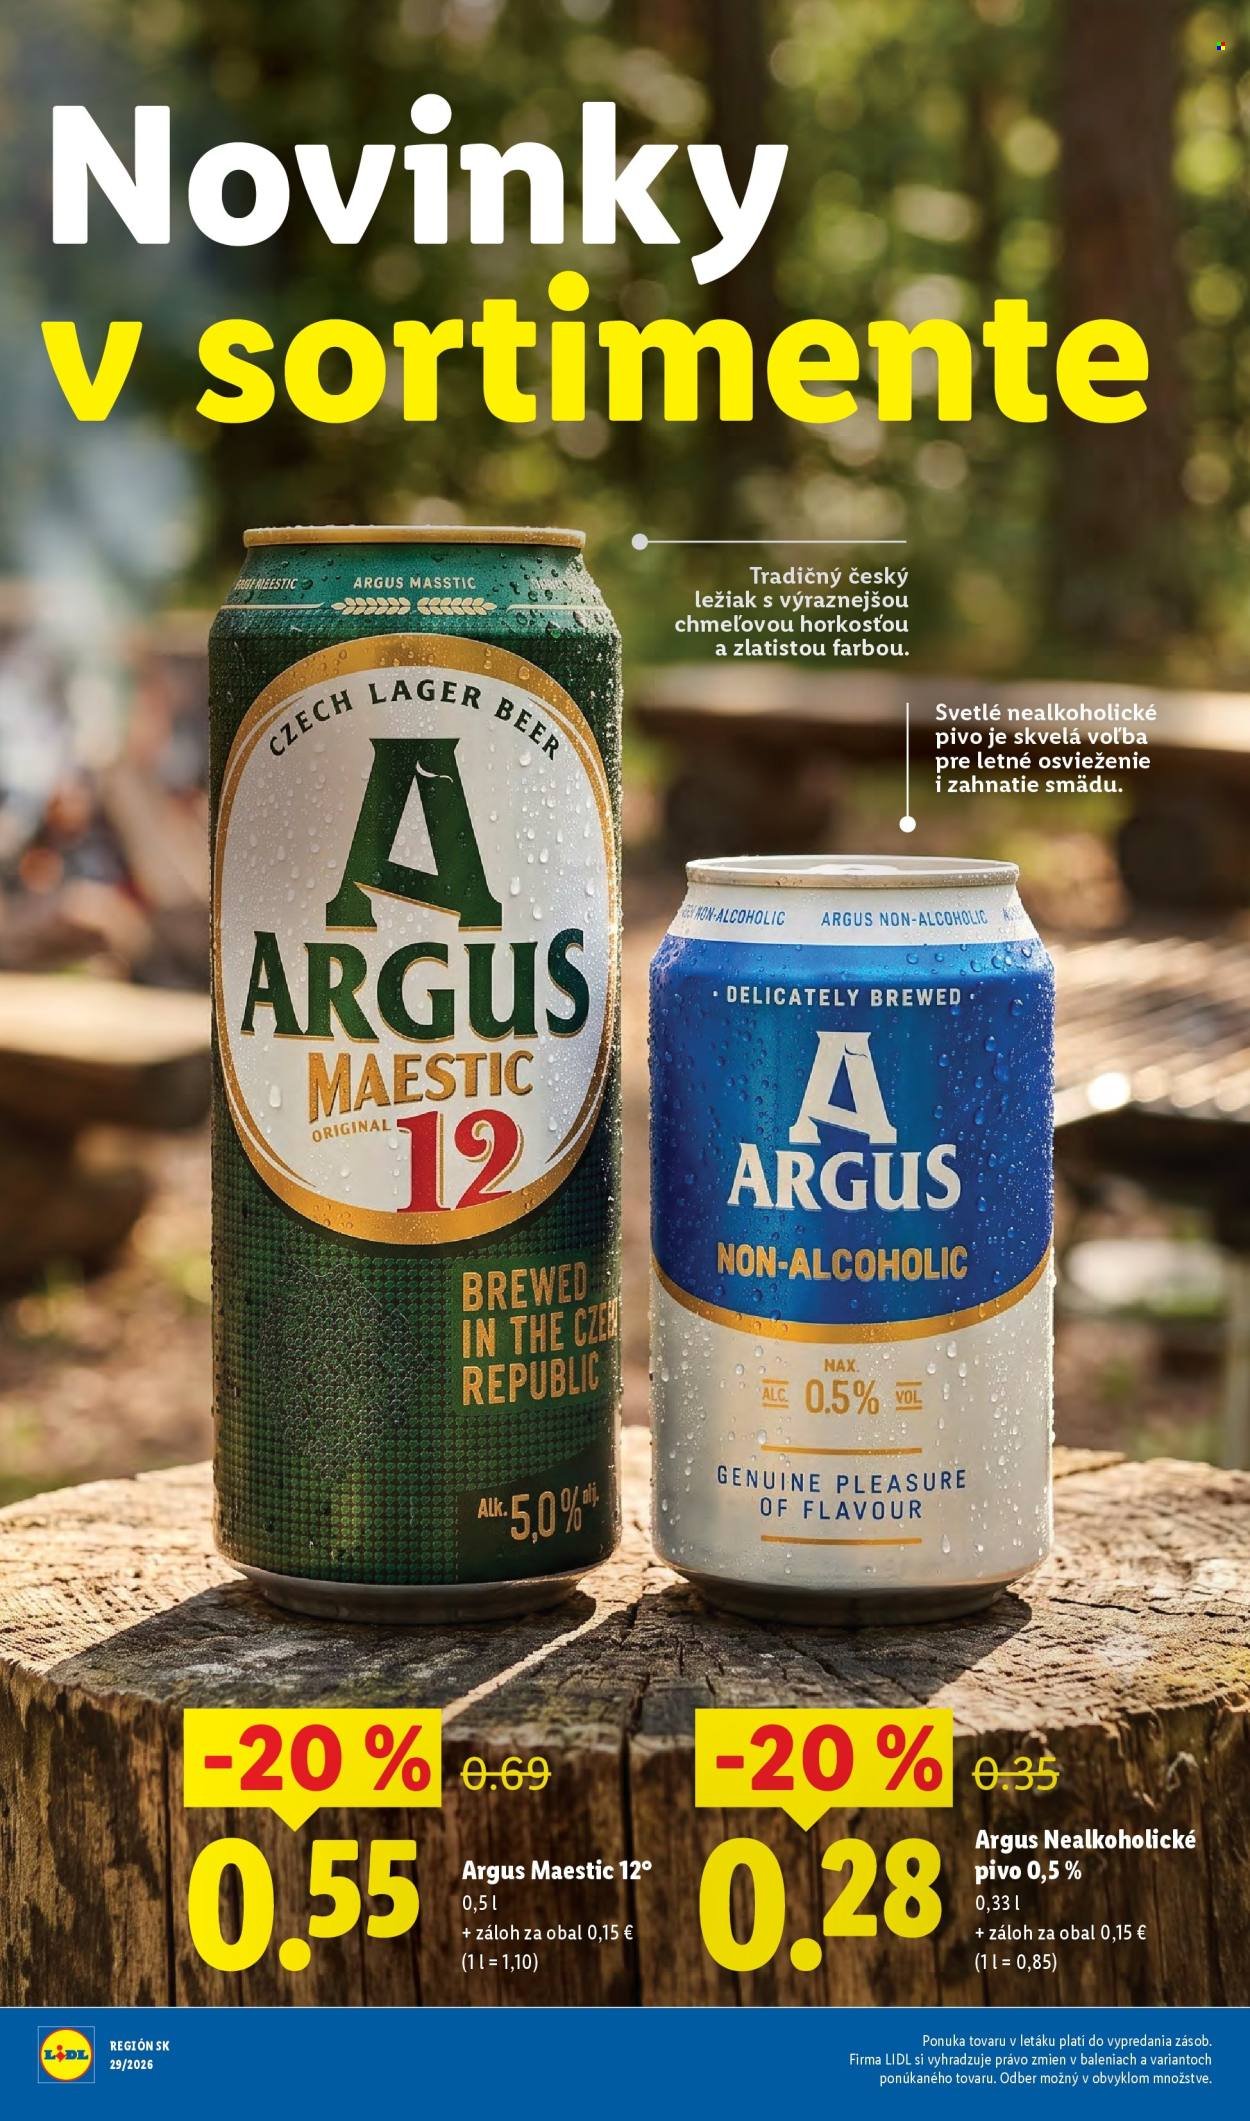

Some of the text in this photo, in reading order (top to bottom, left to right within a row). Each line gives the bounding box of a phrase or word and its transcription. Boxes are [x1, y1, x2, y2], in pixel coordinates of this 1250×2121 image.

[52, 94, 788, 285] Novinky
[41, 270, 1149, 424] v sortimente
[353, 576, 404, 589] ARGUS
[749, 566, 909, 589] Tradičný český
[695, 590, 909, 612] ležiak s výraznejšou
[674, 614, 909, 633] chmeľovou horkosťou
[715, 638, 910, 656] a zlatistou farbou.
[269, 679, 560, 760] CZECH LAGER BEER
[936, 703, 1157, 721] Svetlé nealkoholické
[935, 726, 1148, 749] pivo je skvelá voľba
[935, 751, 1151, 773] pre letné osvieženie
[935, 774, 1123, 793] i zahnatie smädu.
[325, 738, 503, 931] A
[695, 906, 785, 926] NON-ALCOHOLIC
[821, 911, 873, 927] ARGUS
[879, 909, 988, 927] NON-ALCOHOLIC
[240, 928, 590, 1042] ARGUS
[726, 985, 962, 1007] DELICATELY BREWED
[308, 1050, 534, 1124] MAESTIC
[788, 1031, 897, 1145] A
[311, 1109, 524, 1214] ORIGINAL 12
[727, 1142, 962, 1212] ARGUS
[717, 1242, 968, 1282] NON-ALCOHOLIC
[462, 1261, 588, 1312] BREWED
[462, 1317, 495, 1359] IN
[510, 1311, 564, 1354] THE
[462, 1351, 599, 1406] REPUBLIC
[762, 1387, 788, 1402] ALC.
[805, 1378, 879, 1415] 0.5%
[717, 1465, 967, 1494] GENUINE PLEASURE
[477, 1496, 508, 1518] Alk.
[760, 1497, 922, 1520] OF FLAVOUR
[204, 1724, 431, 1792] -20 %
[716, 1724, 943, 1792] -20 %
[460, 1756, 552, 1791] 0.69
[971, 1755, 1060, 1791] 0.35
[975, 1828, 1197, 1855] Argus Nealkoholické
[462, 1860, 525, 1885] Argus
[531, 1859, 614, 1880] Maestic
[974, 1858, 1082, 1885] pivo 0,5 %
[187, 1837, 420, 1972] 0.55
[462, 1894, 497, 1913] 0,5 l
[699, 1837, 942, 1972] 0.28
[975, 1894, 1020, 1914] 0,33 l
[462, 1924, 634, 1942] + záloh za obal 0,15 €
[975, 1924, 1146, 1942] + záloh za obal 0,15 €
[461, 1952, 538, 1973] (1 l = 1,10)
[975, 1952, 1057, 1973] (1 l = 0,85)
[109, 2038, 170, 2052] REGIÓN SK
[922, 2033, 1212, 2050] Ponuka tovaru v letáku platí do vypredania zásob.
[109, 2058, 154, 2072] 29/2026
[849, 2052, 1212, 2069] Firma LIDL si vyhradzuje právo zmien v baleniach a variantoch
[879, 2071, 1212, 2087] ponúkaného tovaru. Odber možný v obvyklom množstve.
